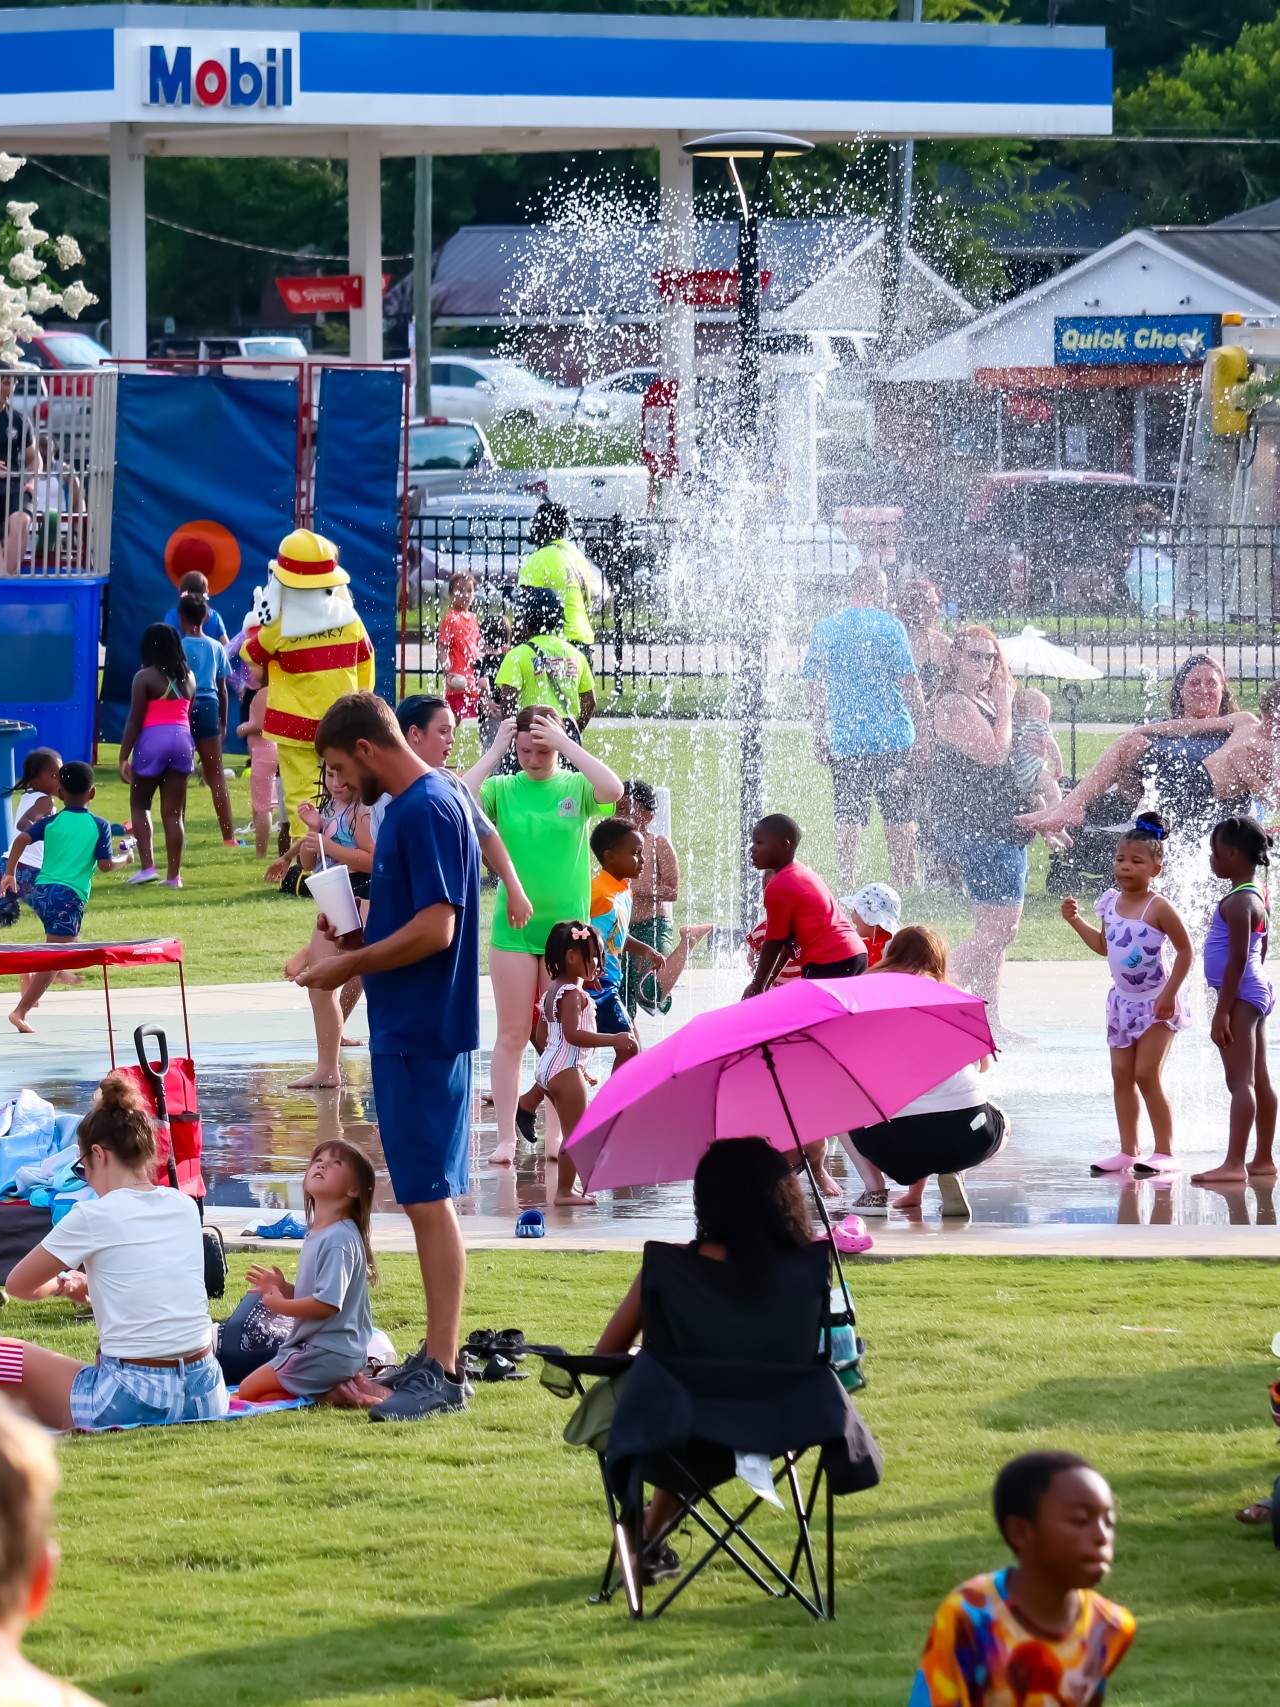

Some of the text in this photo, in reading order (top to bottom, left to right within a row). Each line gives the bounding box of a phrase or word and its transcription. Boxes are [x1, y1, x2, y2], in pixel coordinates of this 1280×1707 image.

[149, 45, 292, 107] Mobil
[1061, 328, 1205, 351] Quick Check
